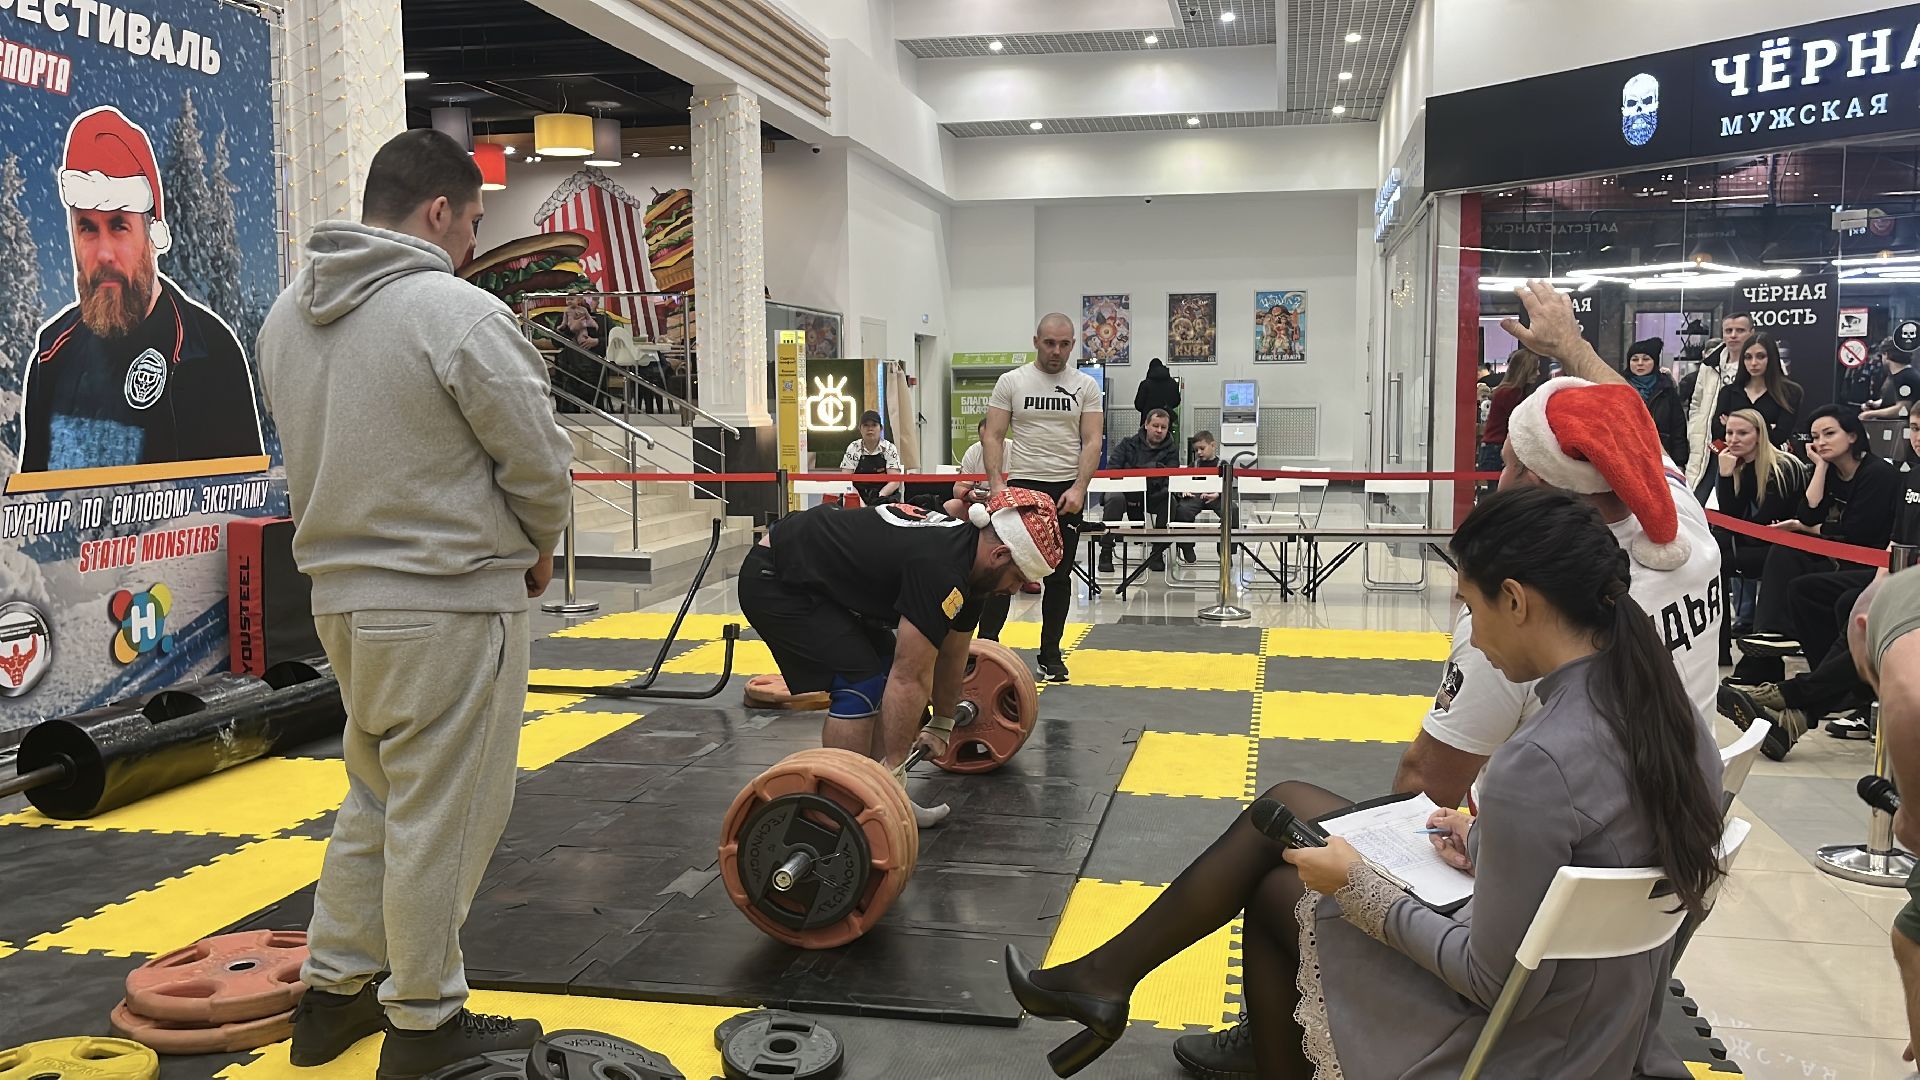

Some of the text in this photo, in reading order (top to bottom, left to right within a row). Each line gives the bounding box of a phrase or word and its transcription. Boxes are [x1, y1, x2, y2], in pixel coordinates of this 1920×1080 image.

[0, 0, 220, 75] ЕСТИВАЛЬ
[1720, 93, 1889, 137] МУЖСКАЯ
[1742, 283, 1828, 303] ЧЁРНАЯ
[1750, 308, 1818, 327] КОСТЬ
[961, 396, 990, 406] БЛАГО
[1024, 396, 1072, 412] PUMA
[3, 481, 269, 537] ТУРНИР ПО СИЛОВОМУ ЭКСТРИМУ
[79, 525, 220, 572] STATIC MONSTERS
[240, 556, 253, 674] YOUSTEEL
[1648, 575, 1720, 651] ДЬЯ
